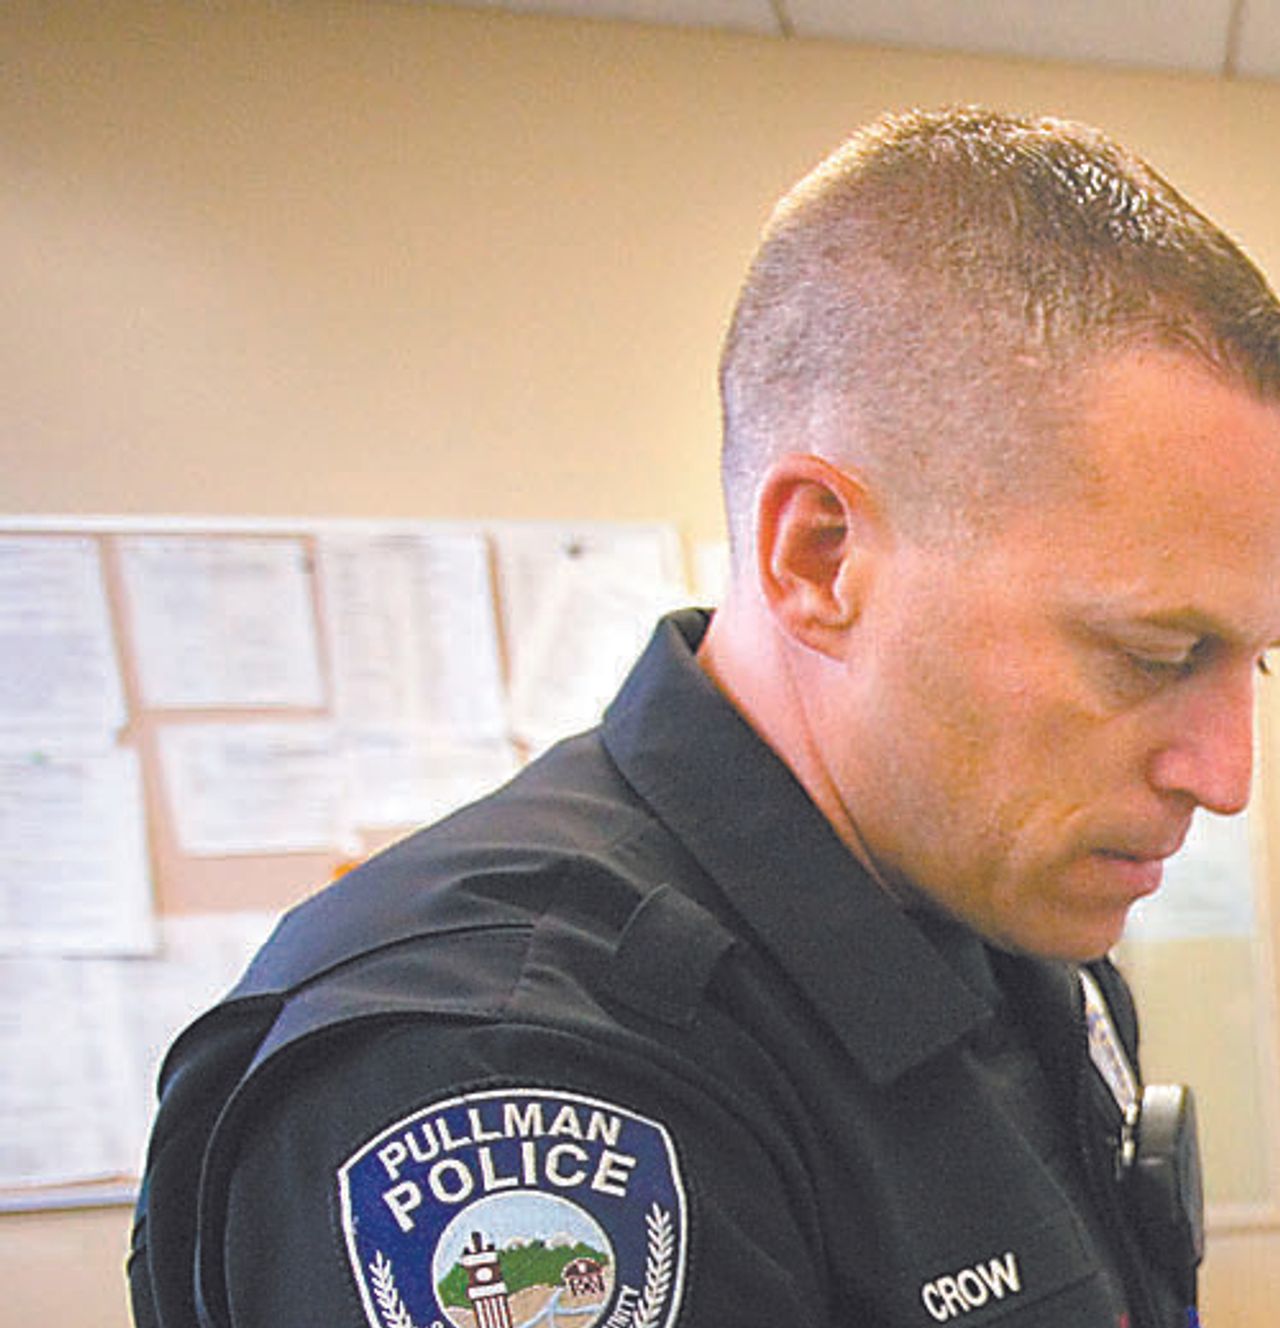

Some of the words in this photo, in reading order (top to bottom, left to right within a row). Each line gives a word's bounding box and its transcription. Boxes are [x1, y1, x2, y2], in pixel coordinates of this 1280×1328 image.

[377, 1102, 622, 1182] PULLMAN
[381, 1141, 638, 1234] POLICE
[921, 1250, 1021, 1323] CROW
